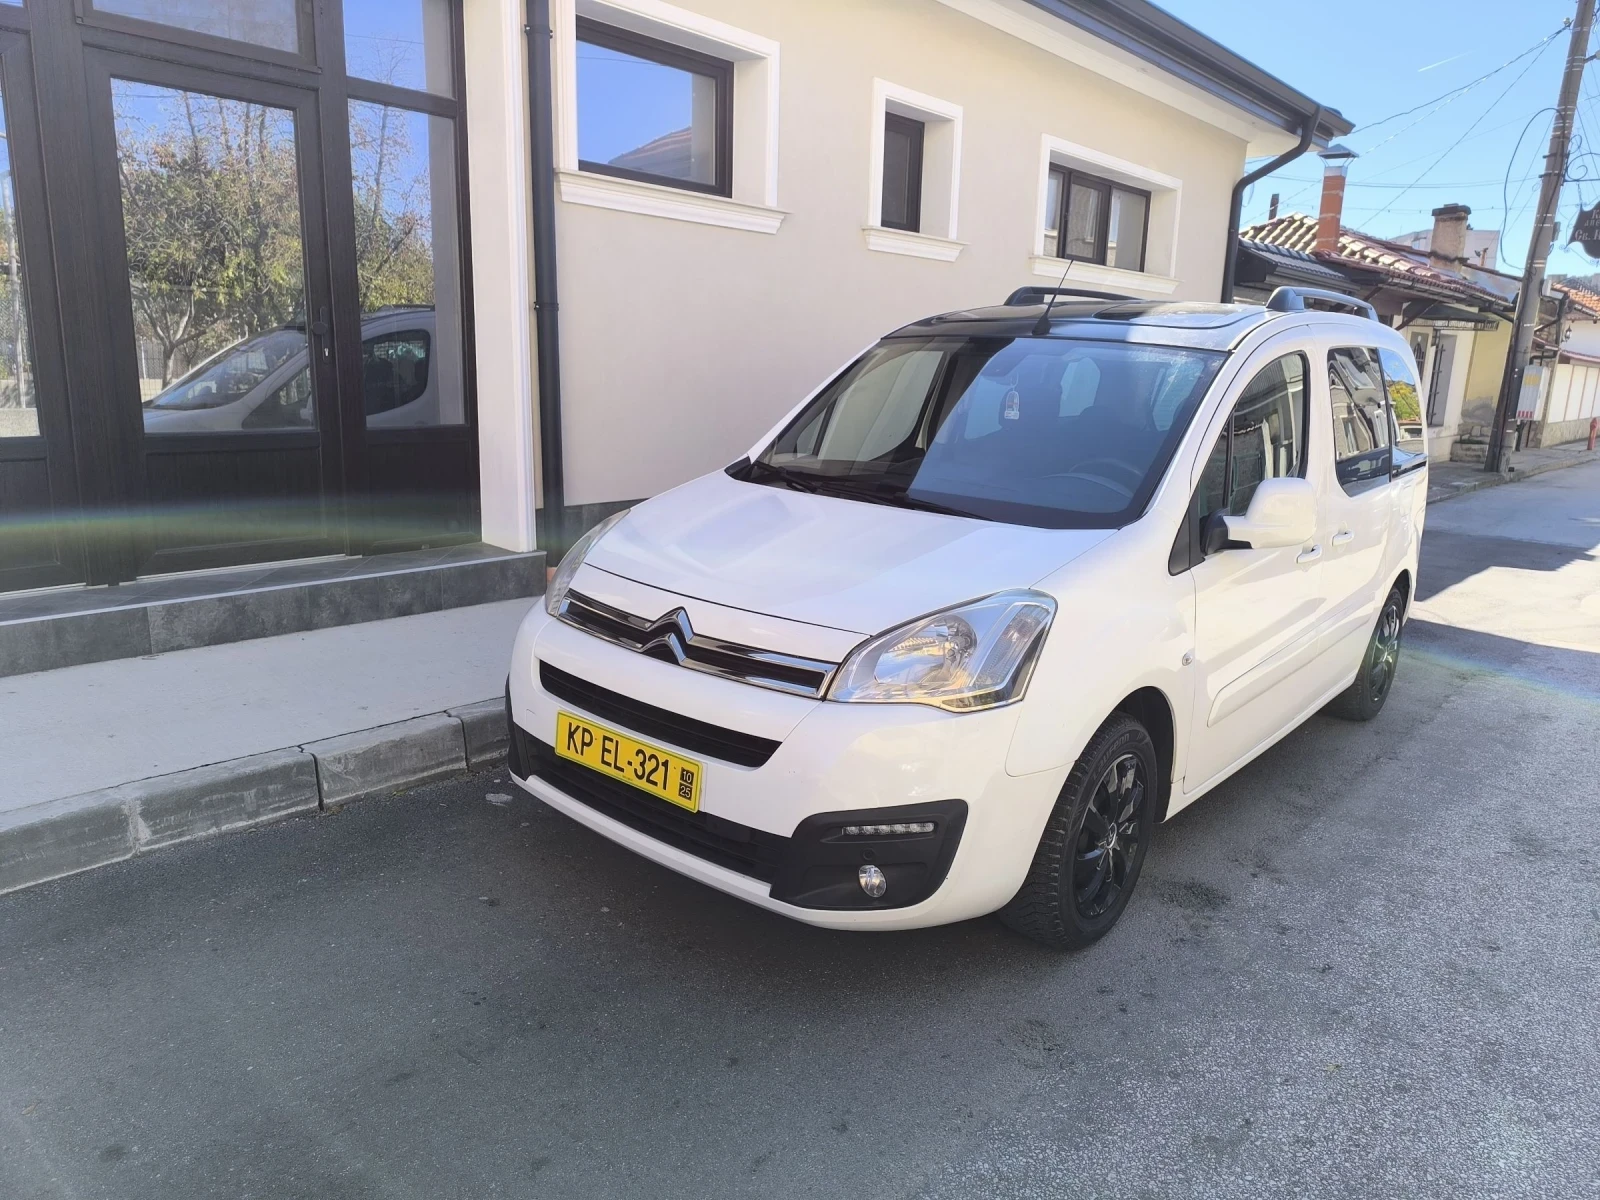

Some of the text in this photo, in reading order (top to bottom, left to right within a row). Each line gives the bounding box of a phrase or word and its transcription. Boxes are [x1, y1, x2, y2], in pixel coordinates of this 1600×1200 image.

[567, 722, 669, 790] KP EL-321
[682, 770, 692, 783] 10
[680, 785, 691, 798] 25
